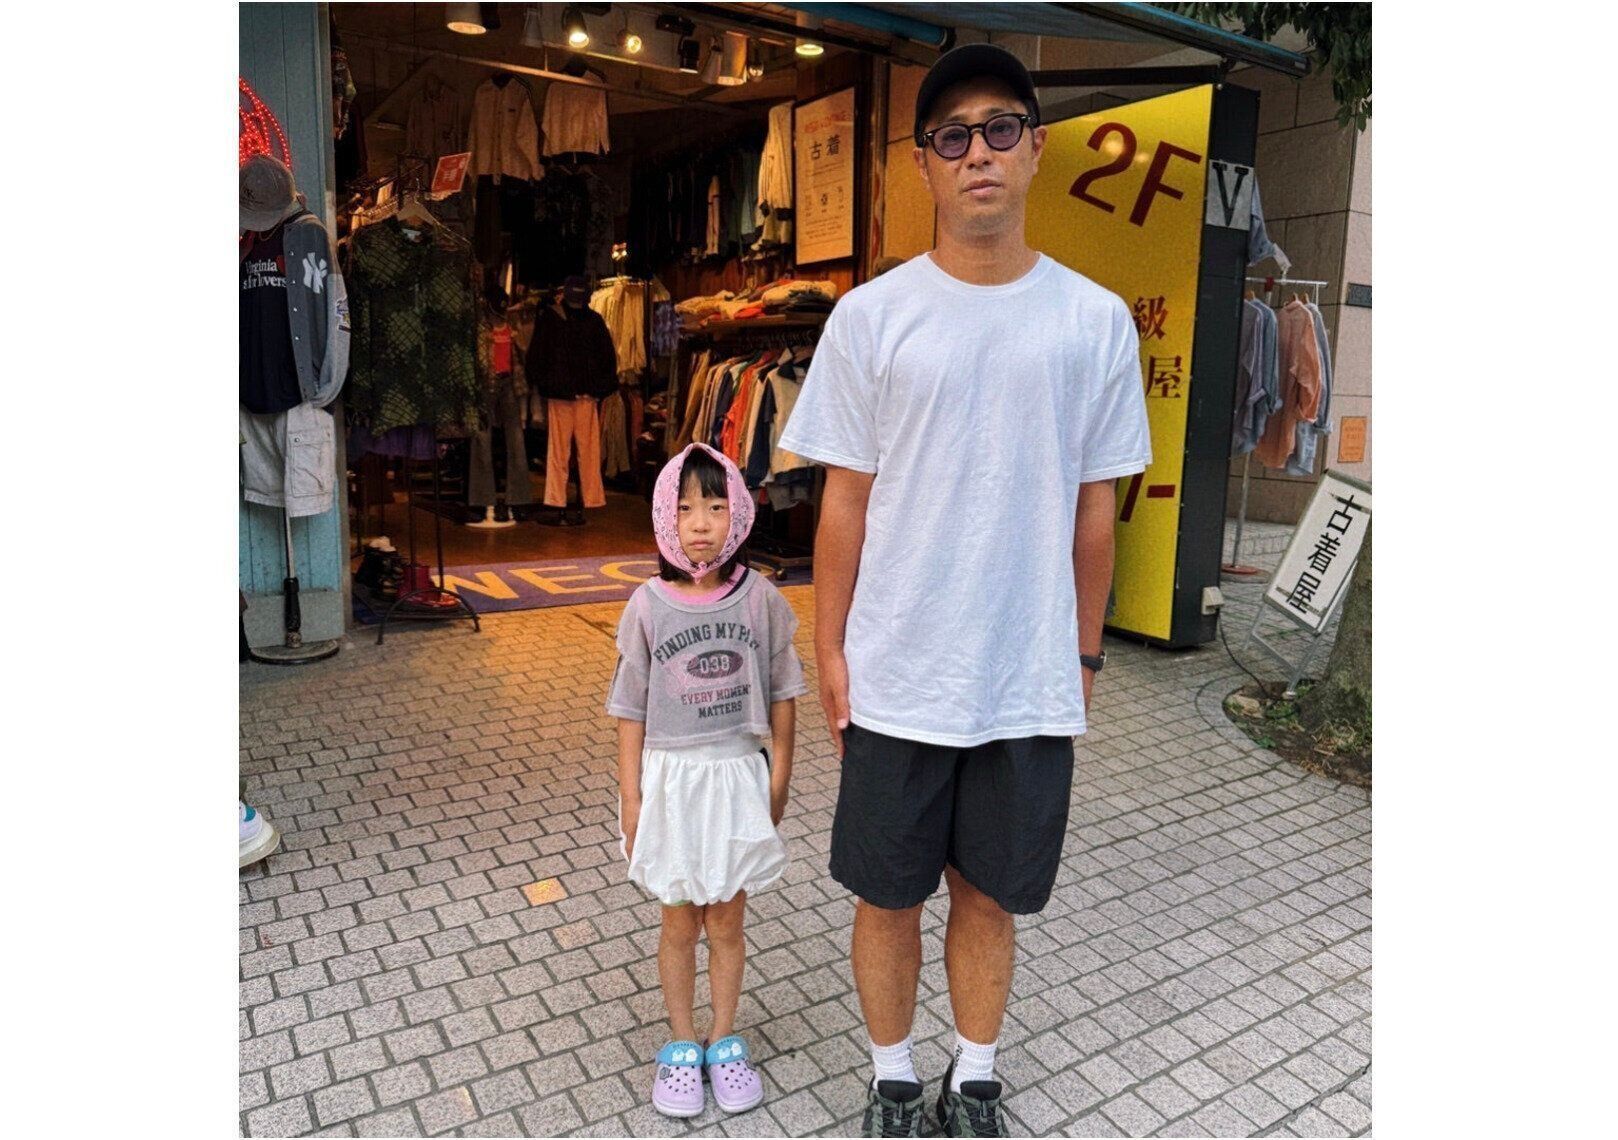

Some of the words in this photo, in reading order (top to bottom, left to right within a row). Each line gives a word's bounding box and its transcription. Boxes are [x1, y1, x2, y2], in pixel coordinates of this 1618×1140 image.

[809, 134, 840, 160] 古着
[1069, 122, 1202, 227] 2F
[1212, 161, 1250, 227] V
[1145, 355, 1183, 399] 屋
[1286, 494, 1362, 614] 古着屋
[654, 625, 712, 665] FINDING
[716, 623, 736, 639] MY
[700, 655, 730, 673] 038
[682, 691, 714, 705] EVERY
[698, 701, 743, 718] MATTERS
